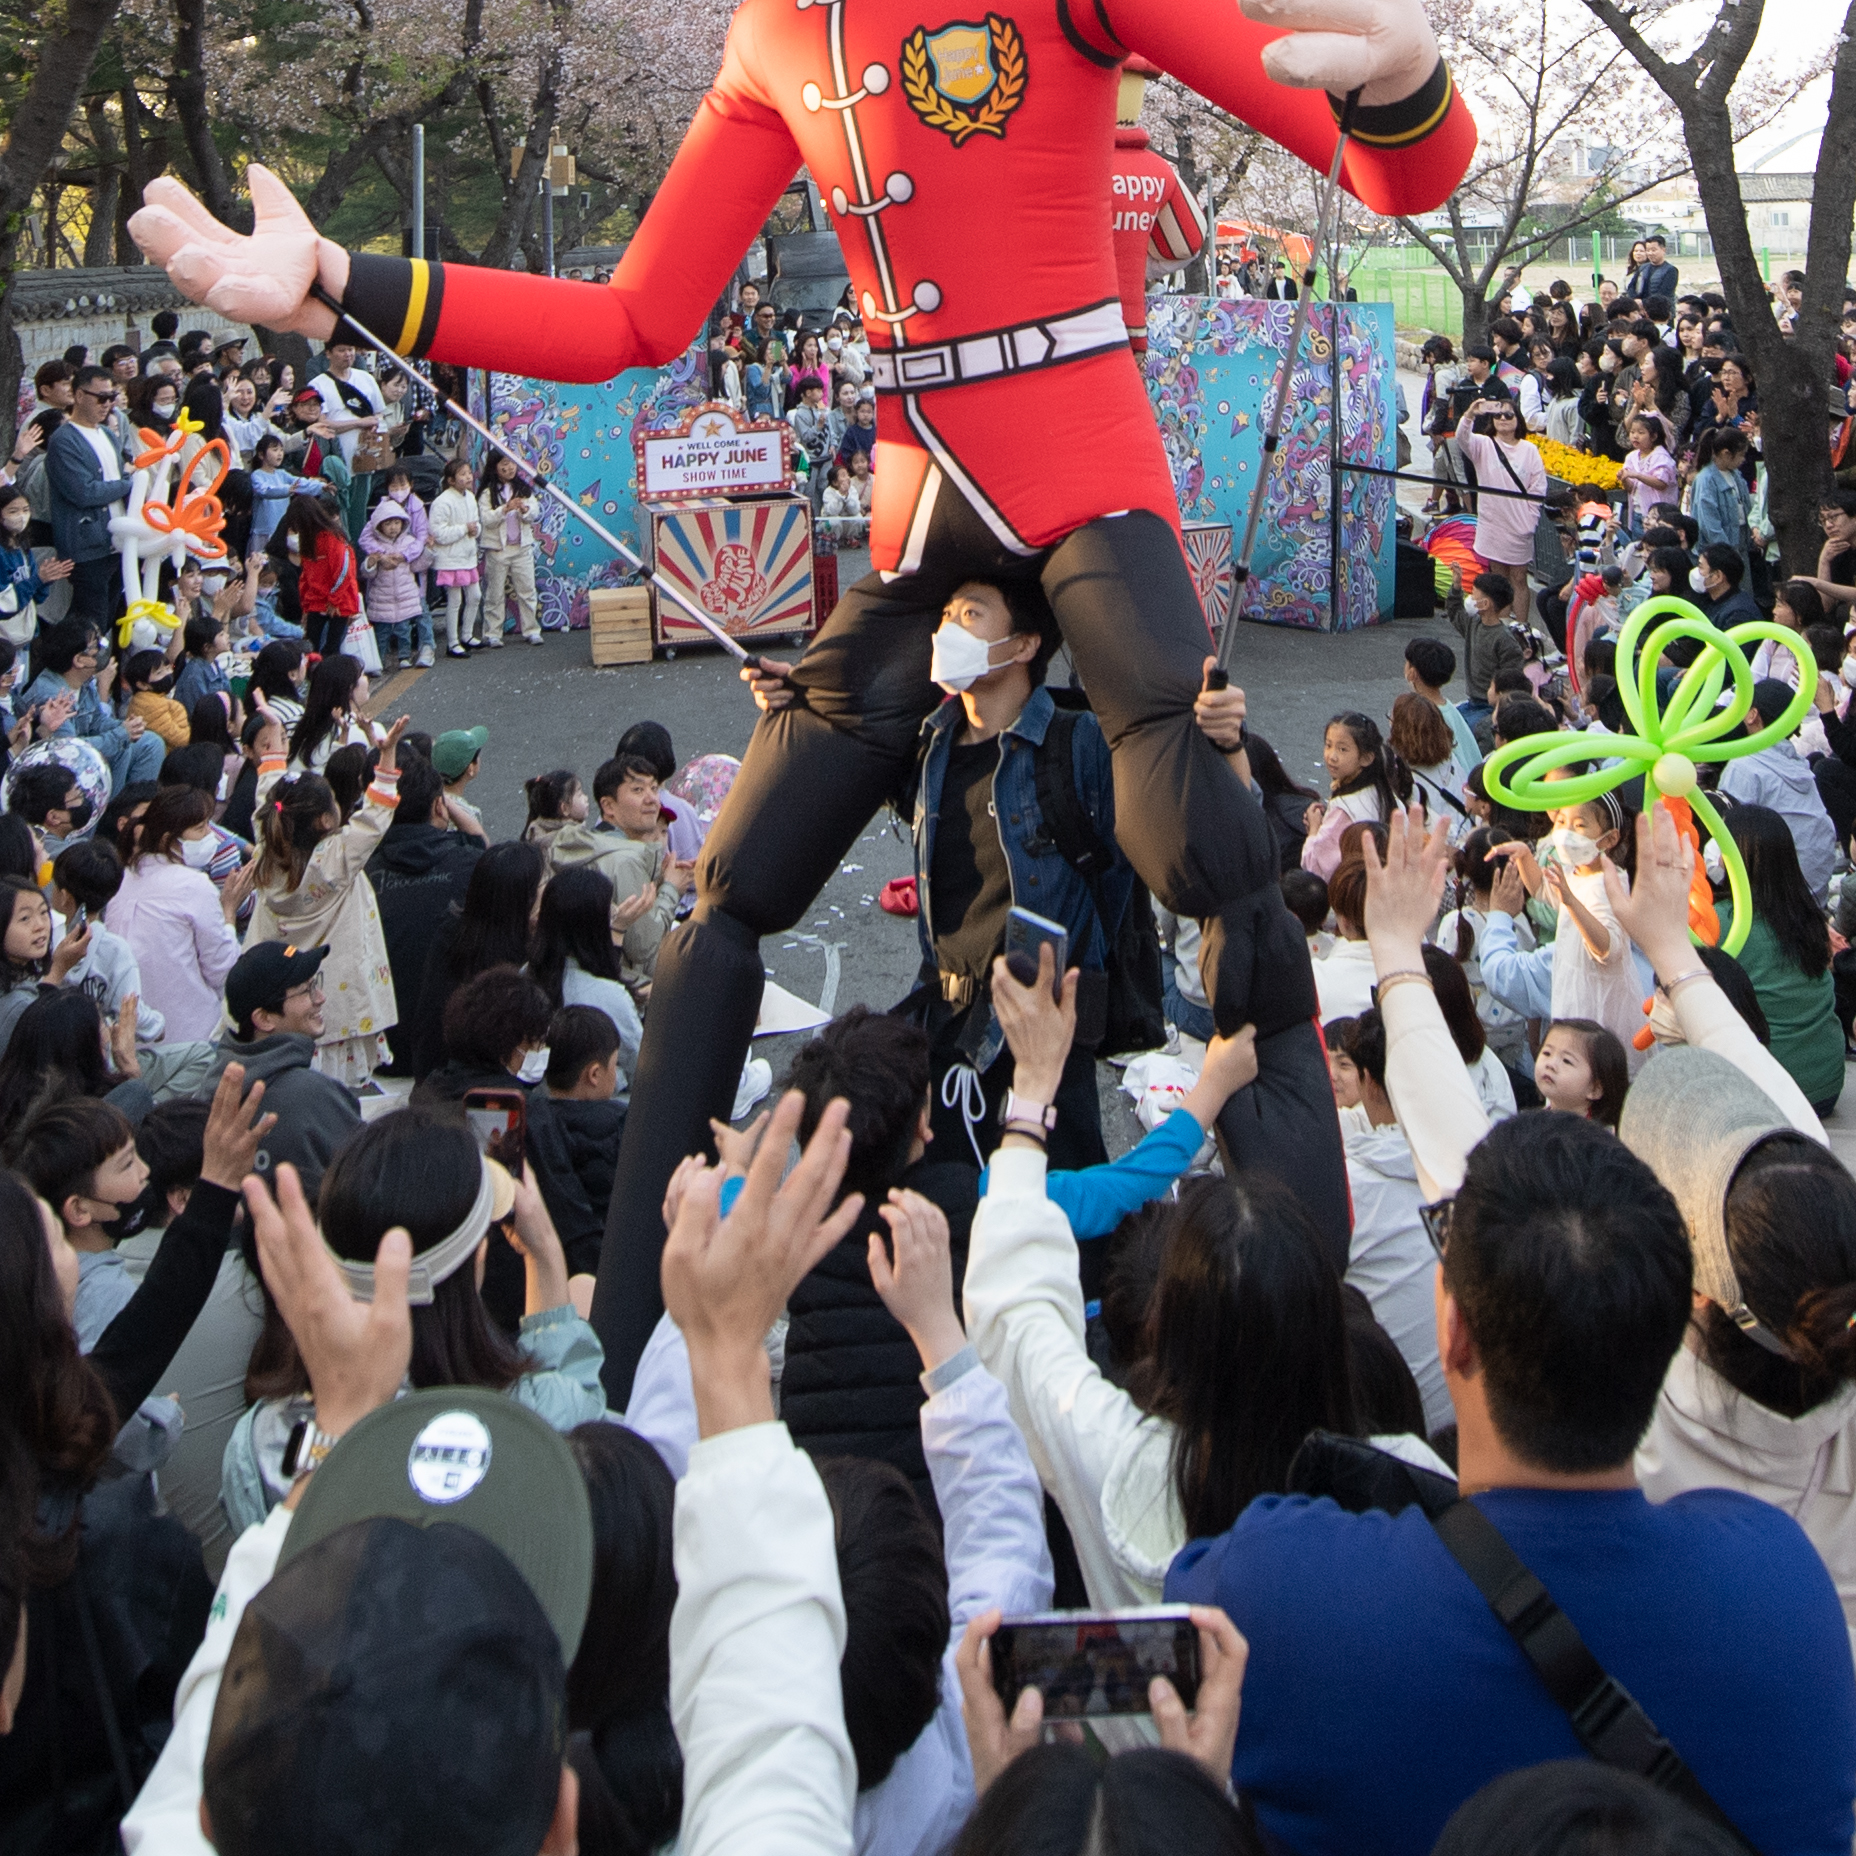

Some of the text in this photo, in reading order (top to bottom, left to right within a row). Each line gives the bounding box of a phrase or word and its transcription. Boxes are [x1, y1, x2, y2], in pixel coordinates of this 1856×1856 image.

[1111, 174, 1165, 203] appy
[687, 440, 741, 450] WELL COME
[662, 448, 768, 470] HAPPY JUNE
[682, 468, 747, 483] SHOW TIME
[729, 548, 754, 603] JUNE
